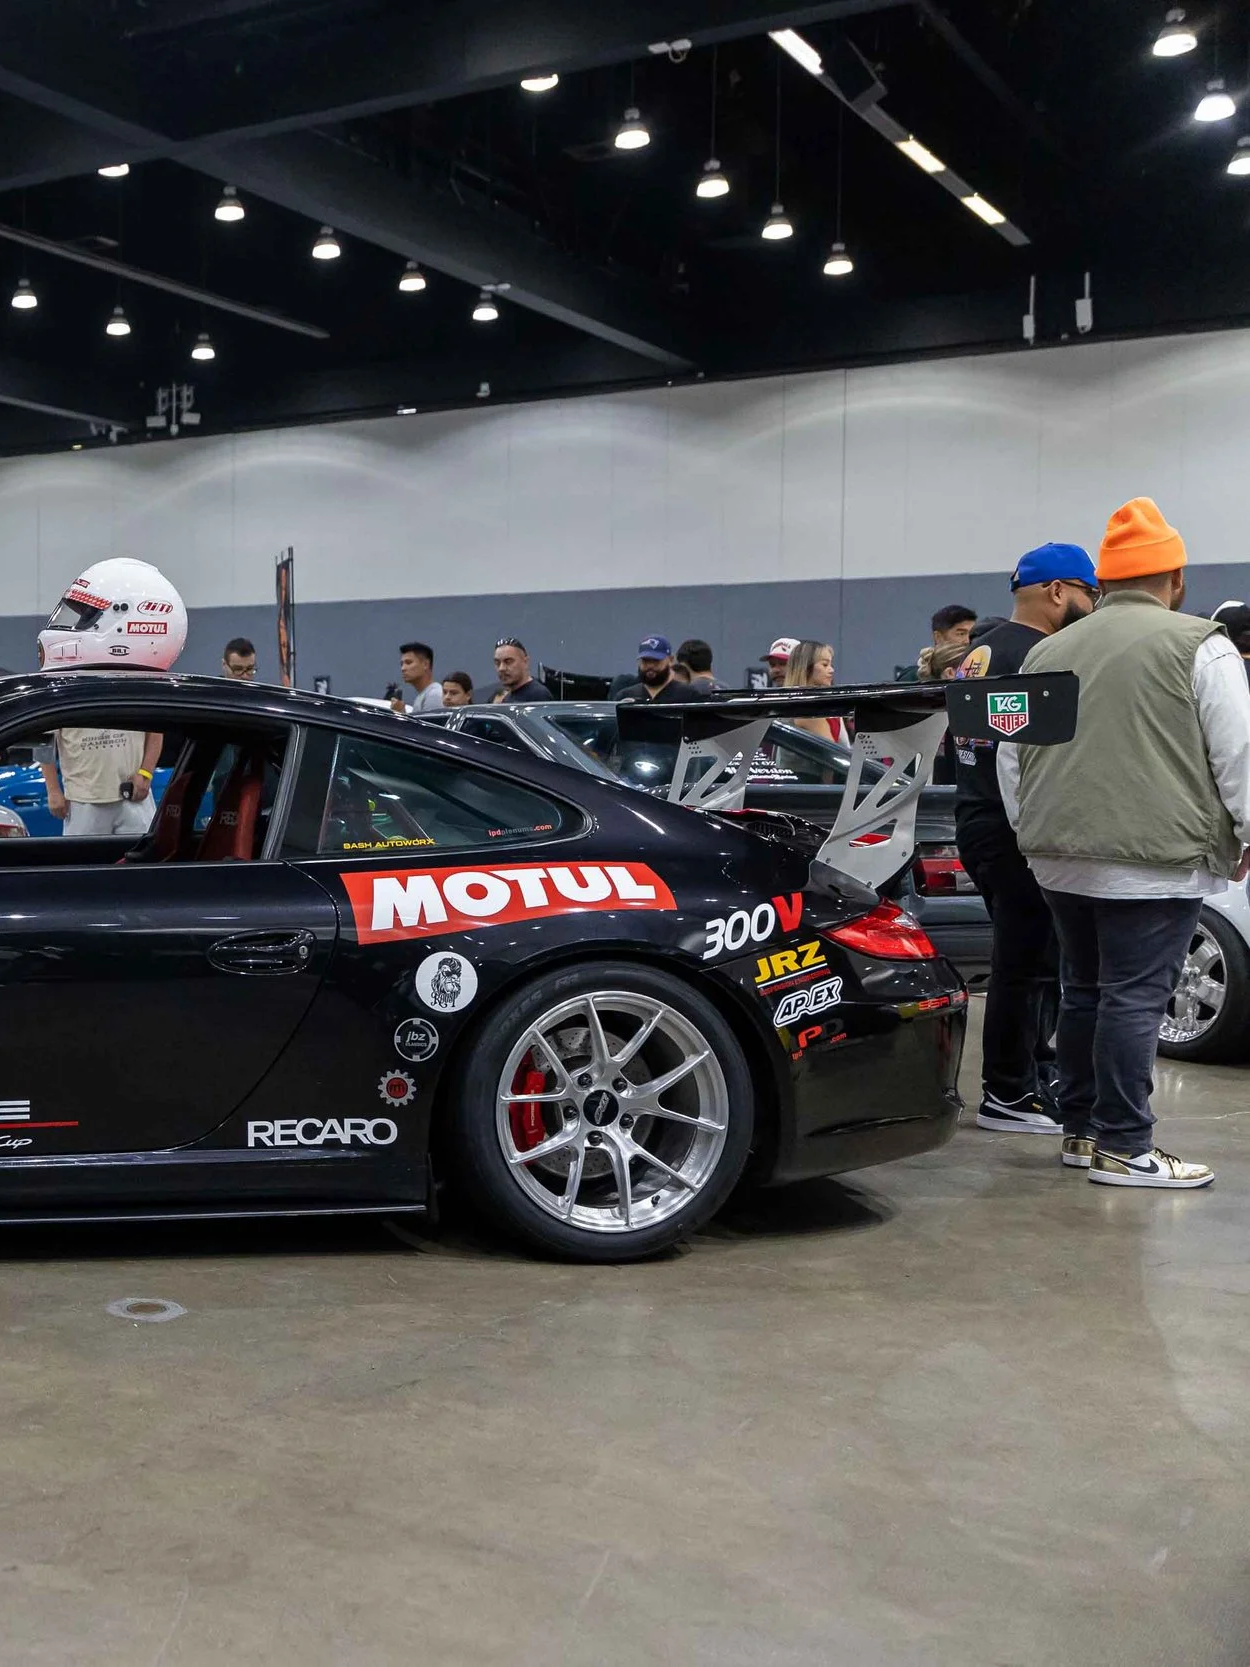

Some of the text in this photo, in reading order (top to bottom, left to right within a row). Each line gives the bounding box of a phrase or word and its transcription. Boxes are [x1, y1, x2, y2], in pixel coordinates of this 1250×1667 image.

[128, 623, 166, 633] MOTUL
[994, 696, 1022, 712] TAG
[992, 714, 1025, 732] HEUER
[343, 839, 435, 850] BASH AUTOWORX
[371, 866, 656, 931] MOTUL
[703, 892, 803, 960] 300V
[754, 940, 826, 983] JRZ
[775, 979, 840, 1024] APEX
[406, 1031, 426, 1043] jbz
[247, 1118, 398, 1147] RECARO
